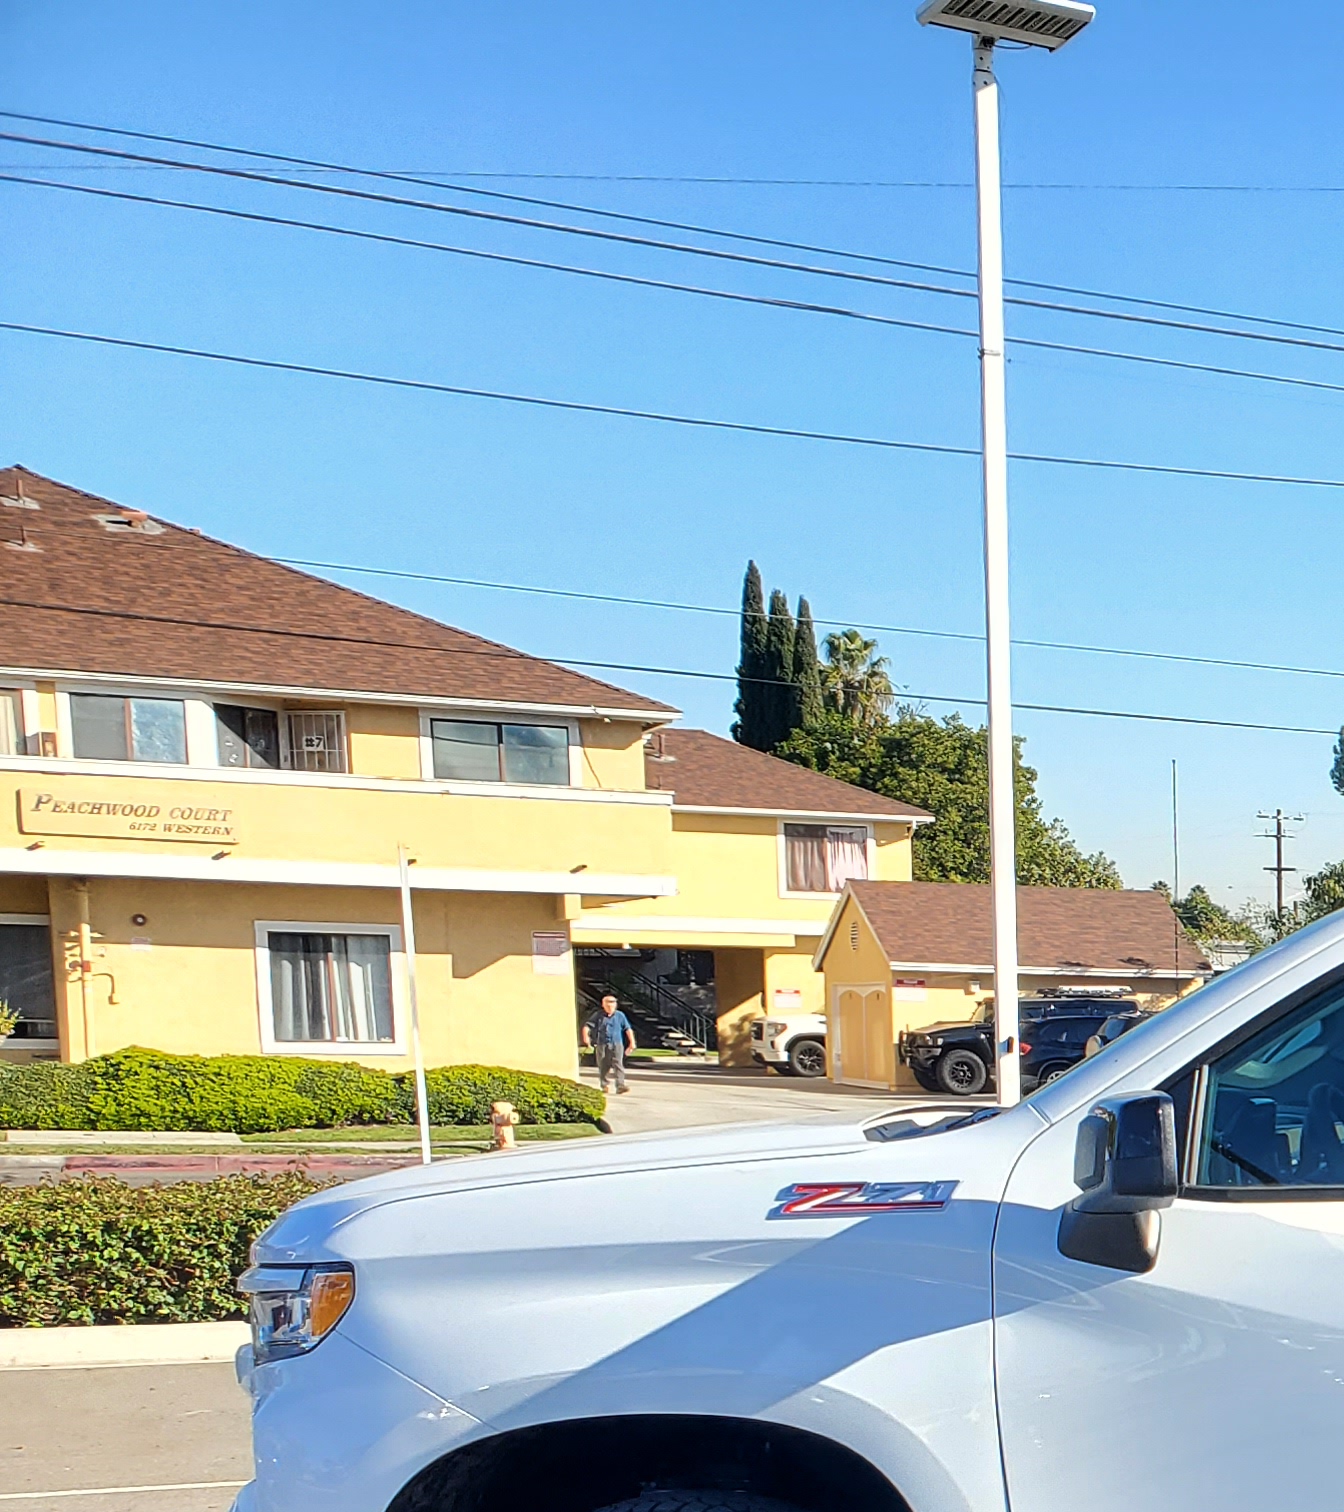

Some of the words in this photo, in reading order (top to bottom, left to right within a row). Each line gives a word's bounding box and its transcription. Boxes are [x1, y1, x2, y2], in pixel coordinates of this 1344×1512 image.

[304, 736, 324, 748] #7
[30, 793, 161, 818] PEACHWOOD
[168, 807, 233, 822] COURT
[128, 821, 158, 832] 6172
[162, 823, 234, 836] WESTERN
[765, 1180, 961, 1220] Z71
